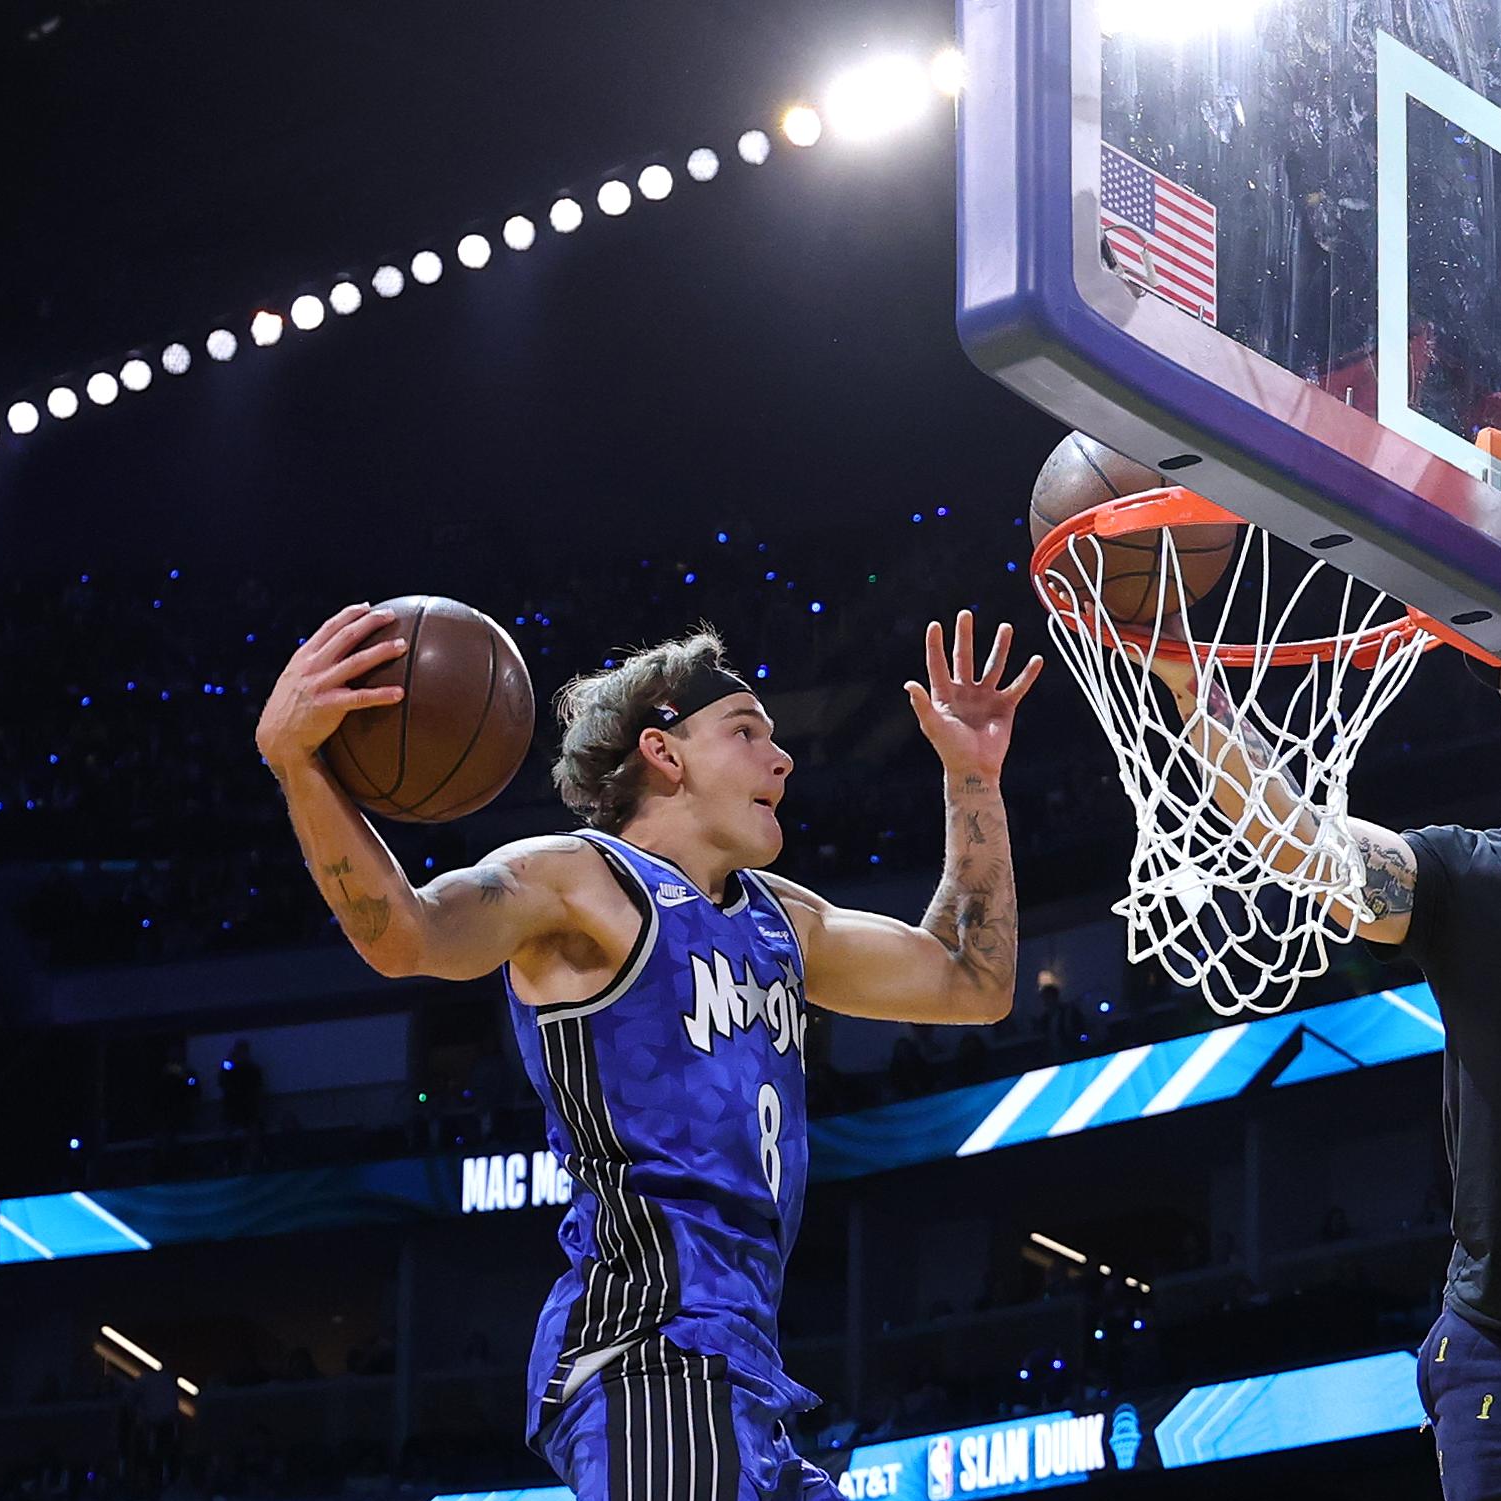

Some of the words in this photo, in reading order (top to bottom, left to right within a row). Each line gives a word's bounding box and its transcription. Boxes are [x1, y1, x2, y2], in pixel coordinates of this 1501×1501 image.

[659, 882, 687, 899] NIKE
[757, 1083, 782, 1204] 8
[462, 1154, 527, 1213] MAC
[837, 1462, 902, 1500] AT&T
[960, 1430, 1030, 1491] SLAM
[1034, 1414, 1106, 1479] DUNK
